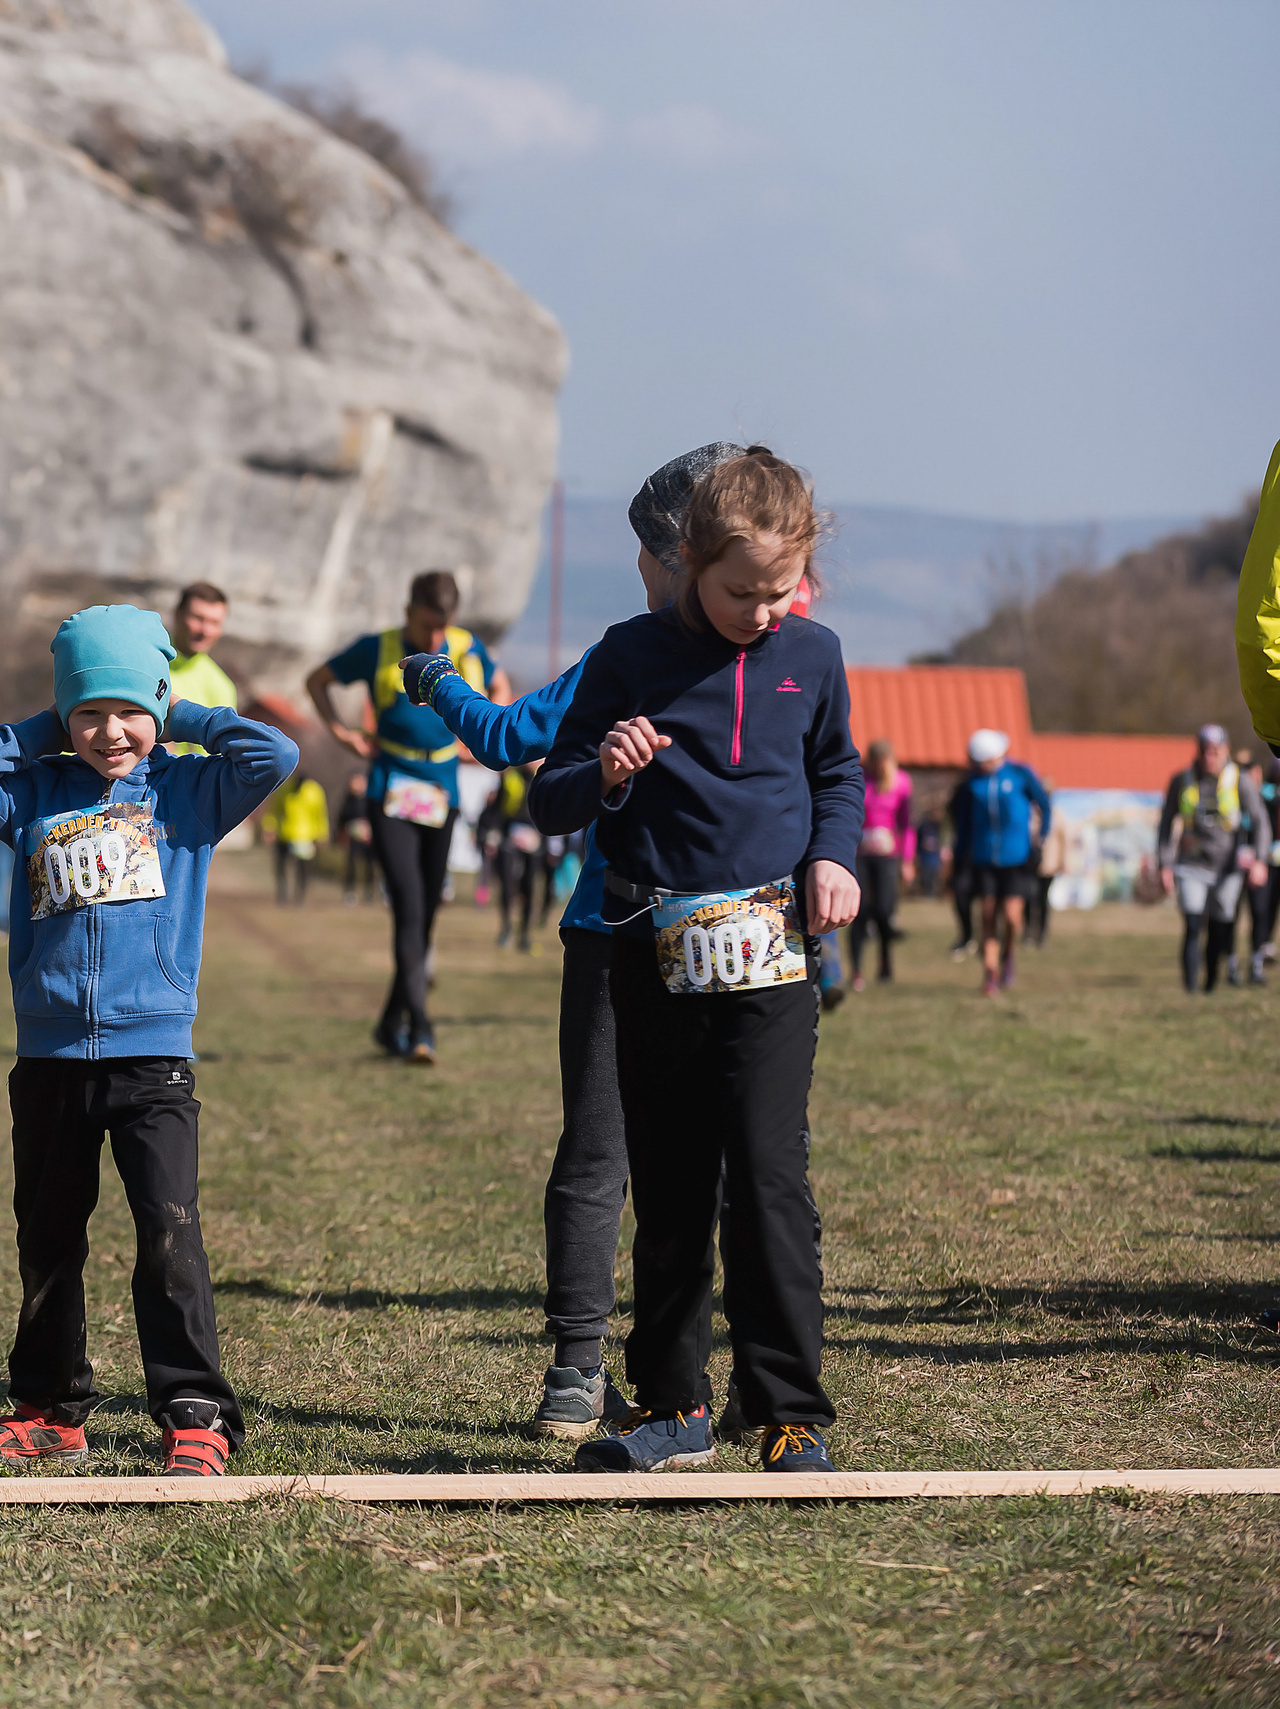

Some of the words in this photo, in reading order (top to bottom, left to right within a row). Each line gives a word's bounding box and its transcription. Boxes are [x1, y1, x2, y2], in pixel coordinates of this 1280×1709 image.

[110, 817, 143, 843] TRAIL
[44, 833, 126, 904] 009
[666, 901, 750, 941] ESKI-KERMEN
[683, 919, 775, 986] 002
